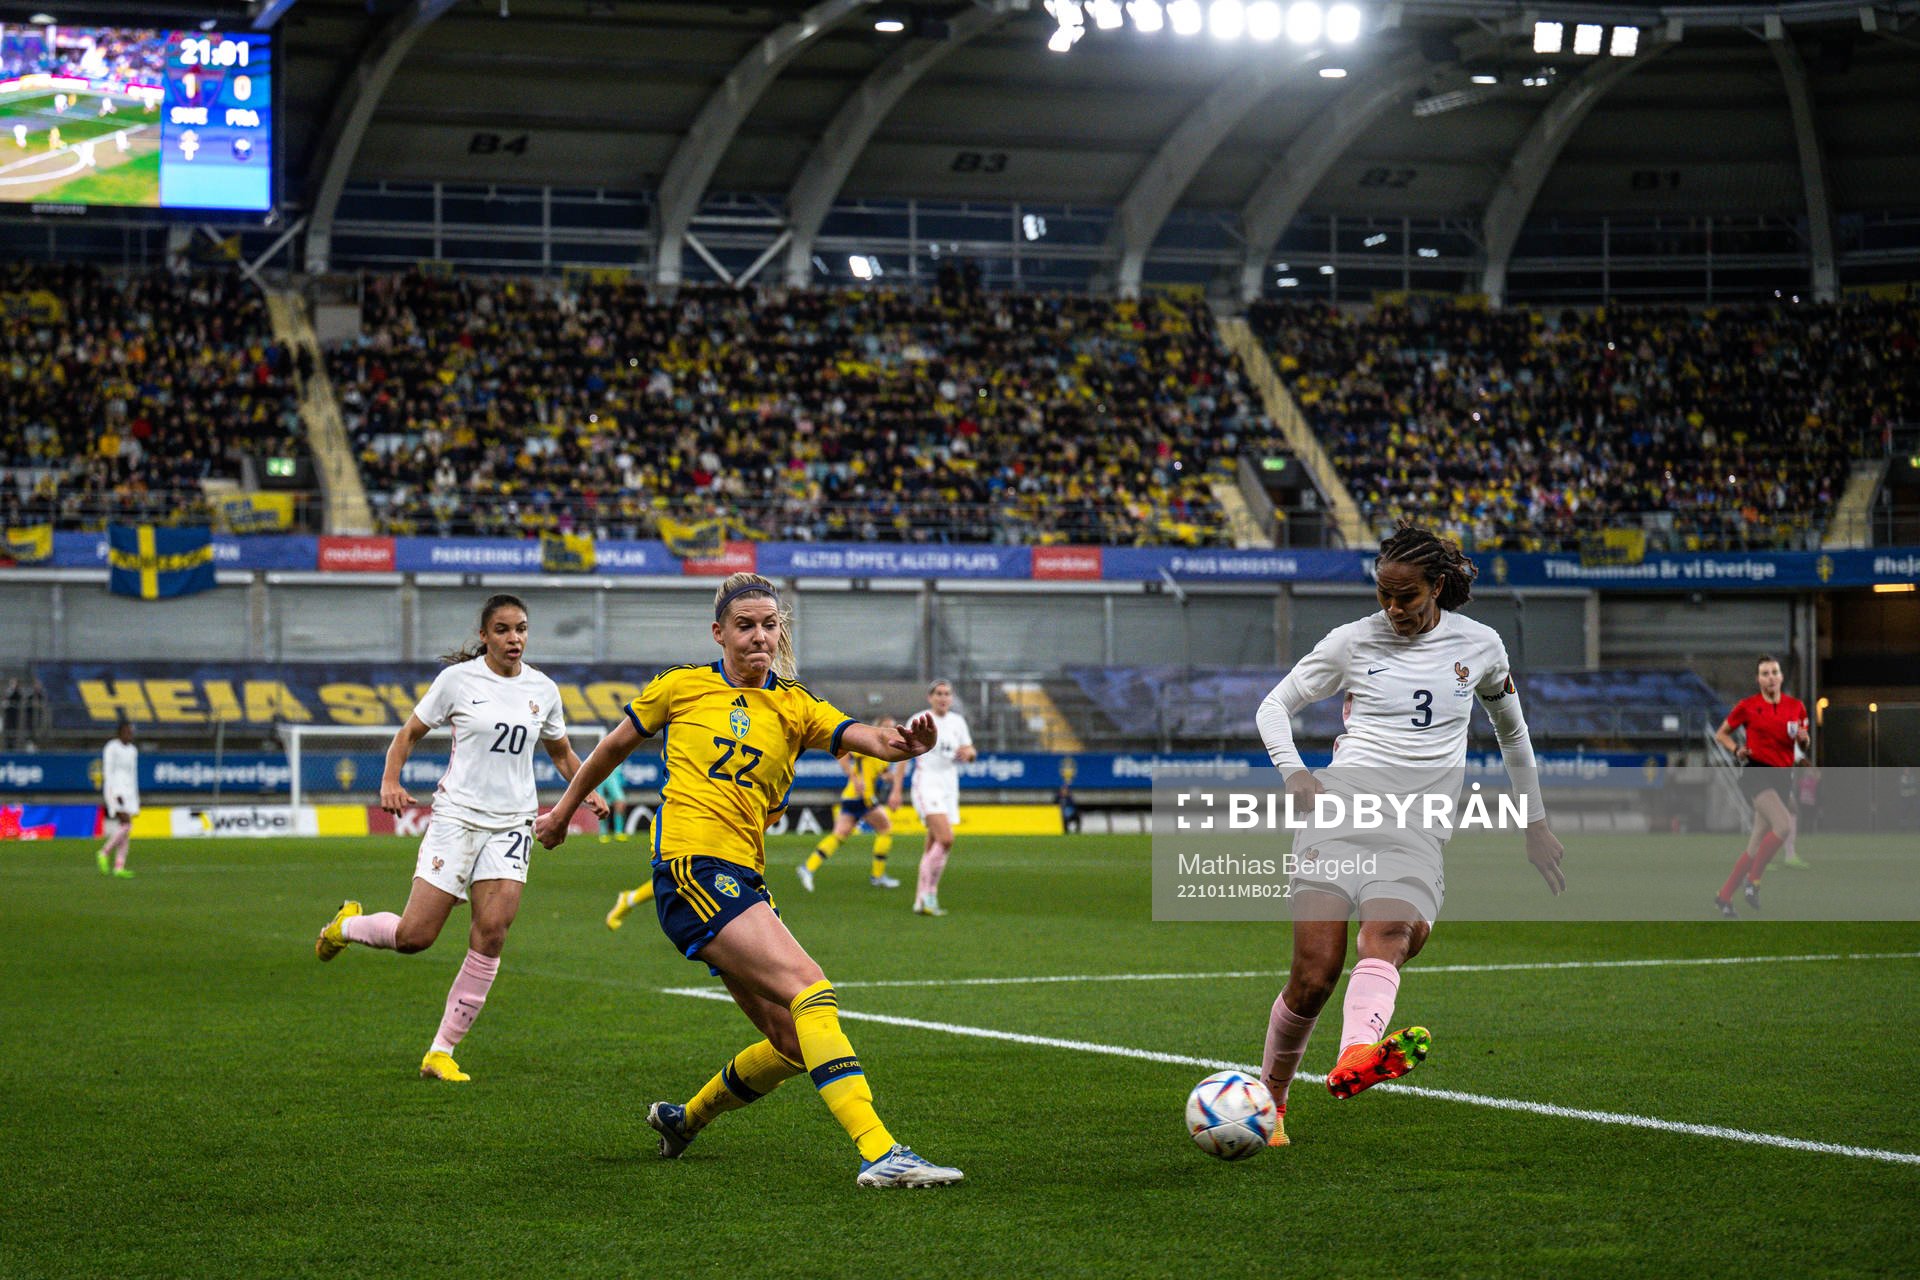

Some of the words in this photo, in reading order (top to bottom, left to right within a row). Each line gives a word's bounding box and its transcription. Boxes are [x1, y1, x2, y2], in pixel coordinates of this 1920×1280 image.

[180, 38, 249, 67] 21:01
[182, 72, 197, 99] 1
[233, 74, 252, 101] 0
[467, 132, 529, 155] B4
[951, 151, 1008, 172] B3
[432, 546, 522, 565] PARKERING
[791, 552, 842, 569] ALLTID
[901, 553, 950, 570] ALLTID
[952, 553, 998, 570] PLATS
[1219, 557, 1297, 574] NORDSTAN
[1660, 559, 1680, 578] är
[1683, 560, 1701, 578] vi
[1703, 559, 1776, 580] Sverige
[78, 679, 313, 723] HEJA
[1411, 689, 1433, 727] 3
[490, 722, 528, 755] 20
[154, 760, 291, 784] #hejasverige
[708, 736, 763, 789] 22
[504, 831, 534, 865] 20
